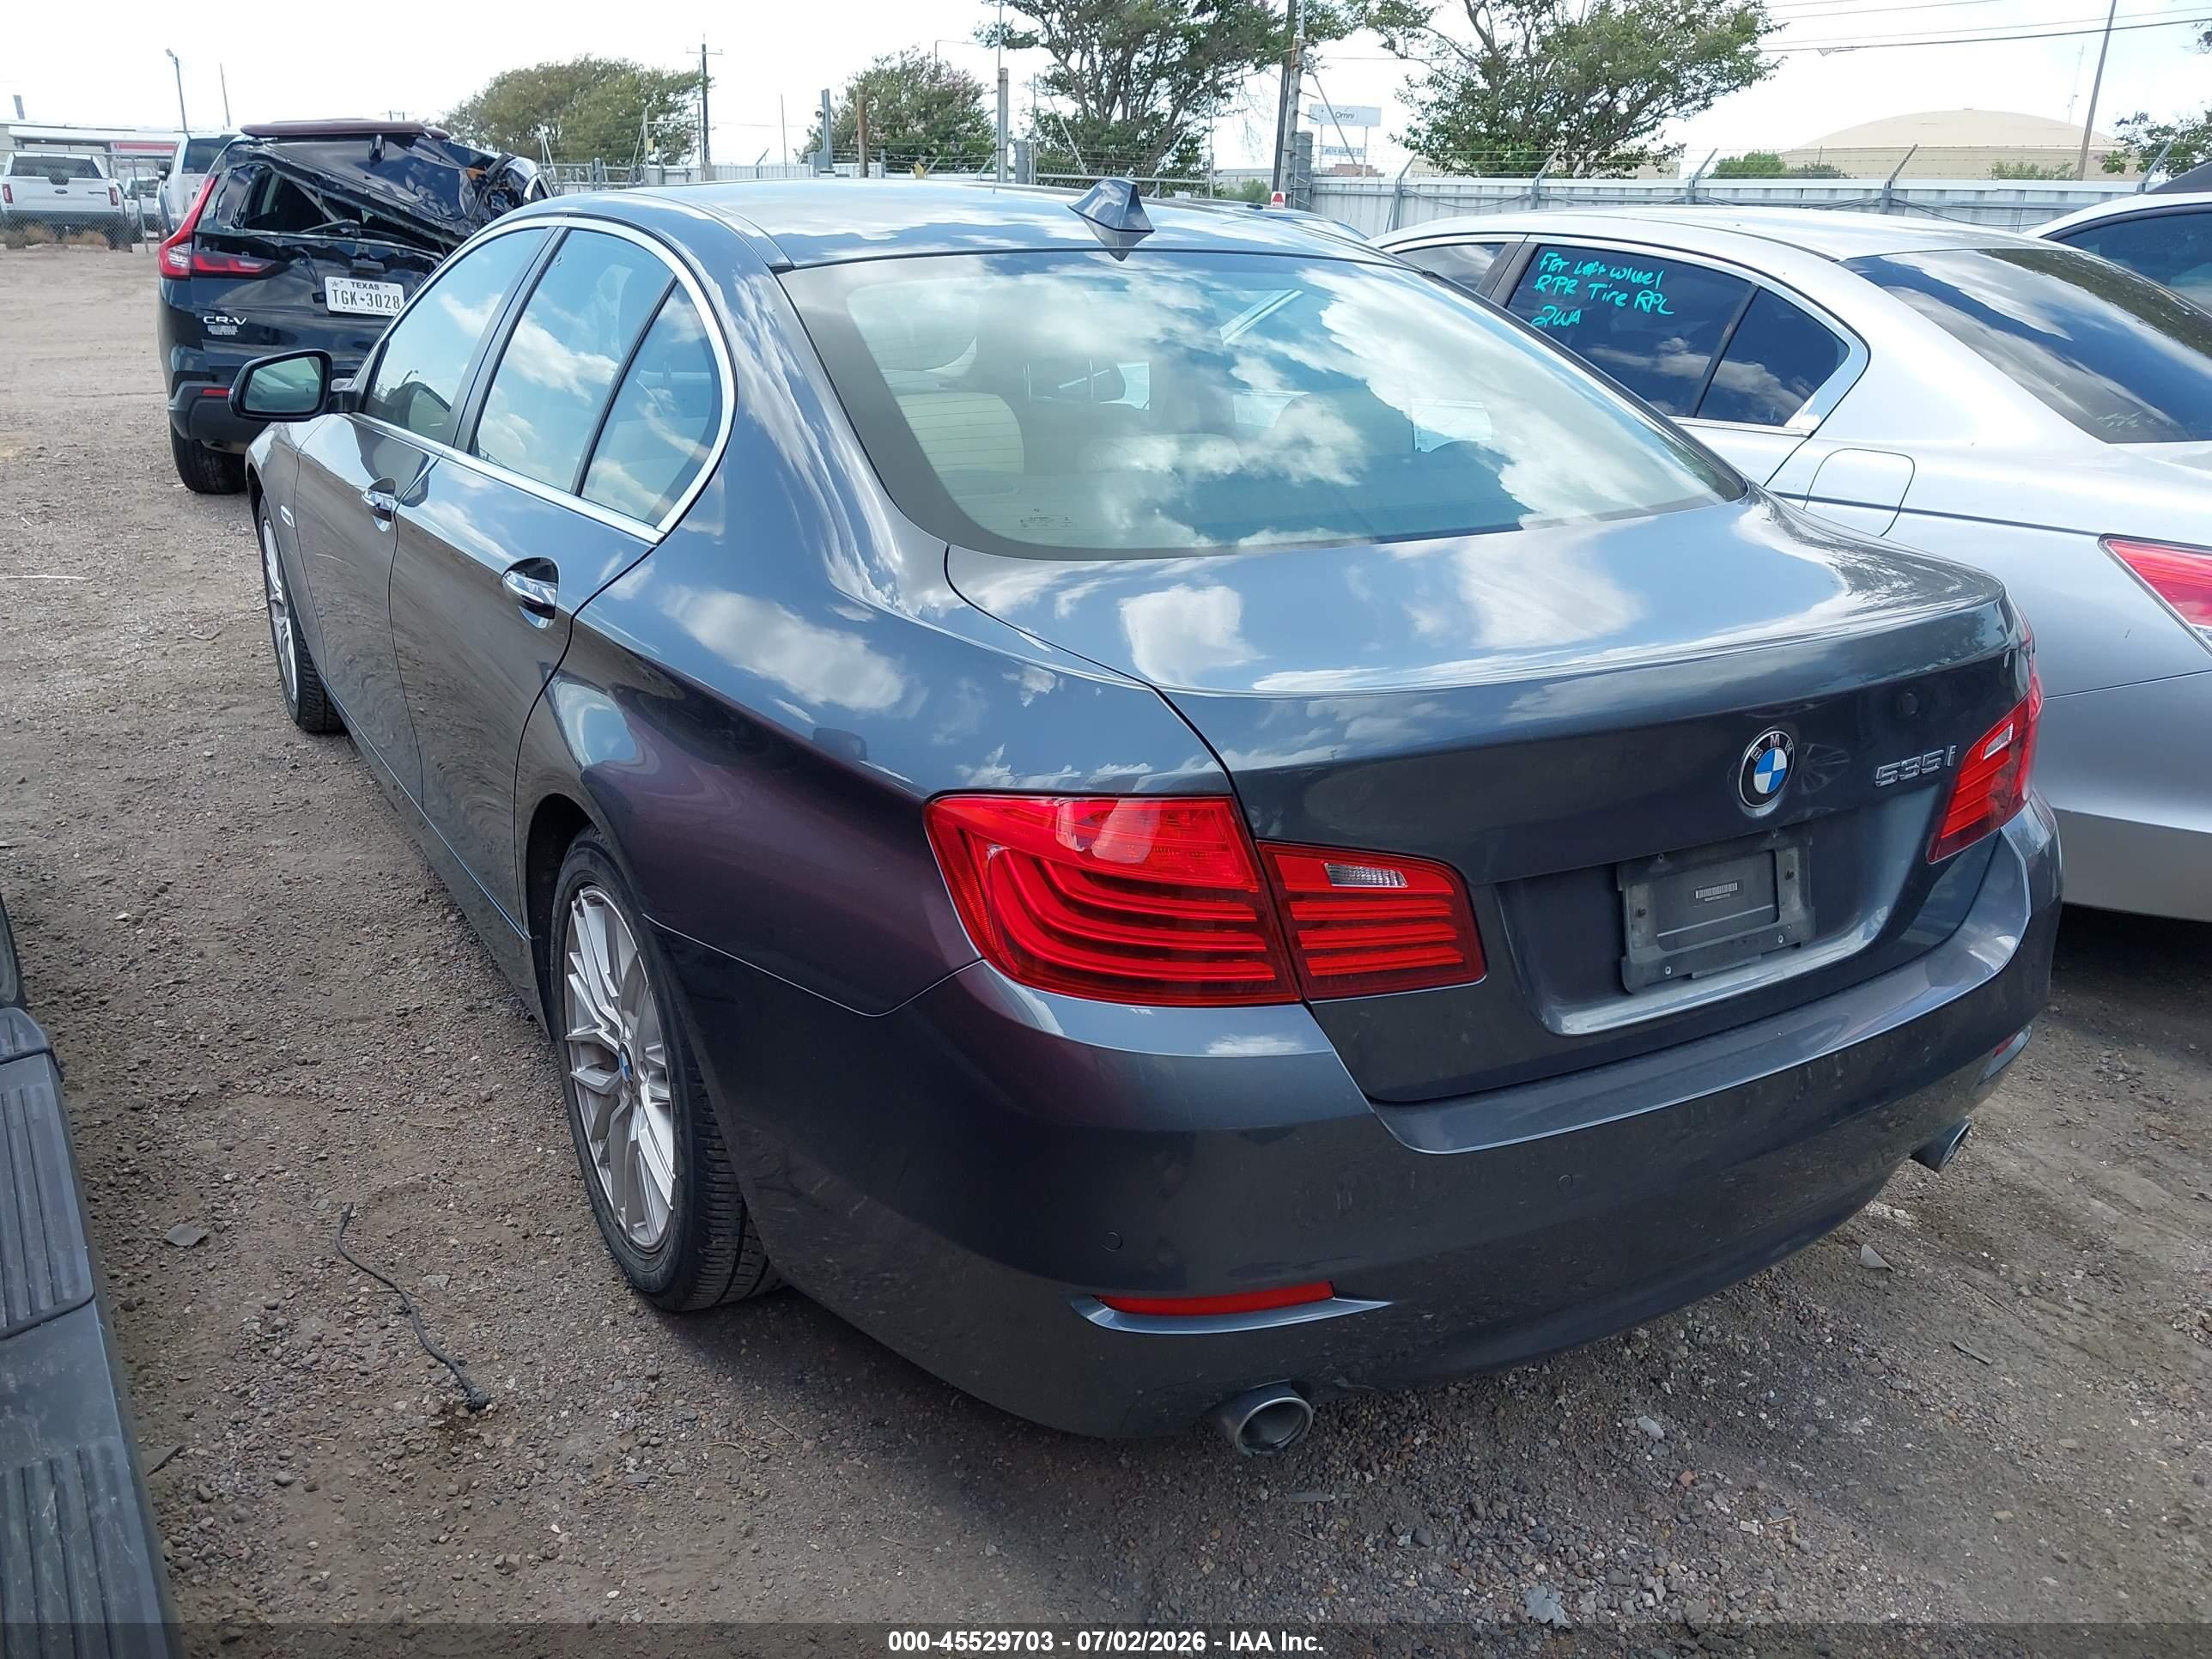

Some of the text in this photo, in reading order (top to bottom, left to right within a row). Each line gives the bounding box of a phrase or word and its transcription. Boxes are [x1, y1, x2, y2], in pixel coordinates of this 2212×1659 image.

[1334, 111, 1355, 119] Omni
[350, 281, 380, 290] TEXAS
[1588, 283, 1629, 307] Tire
[203, 316, 247, 325] CR-V
[1751, 733, 1795, 763] BMW
[1875, 744, 1958, 787] 535i
